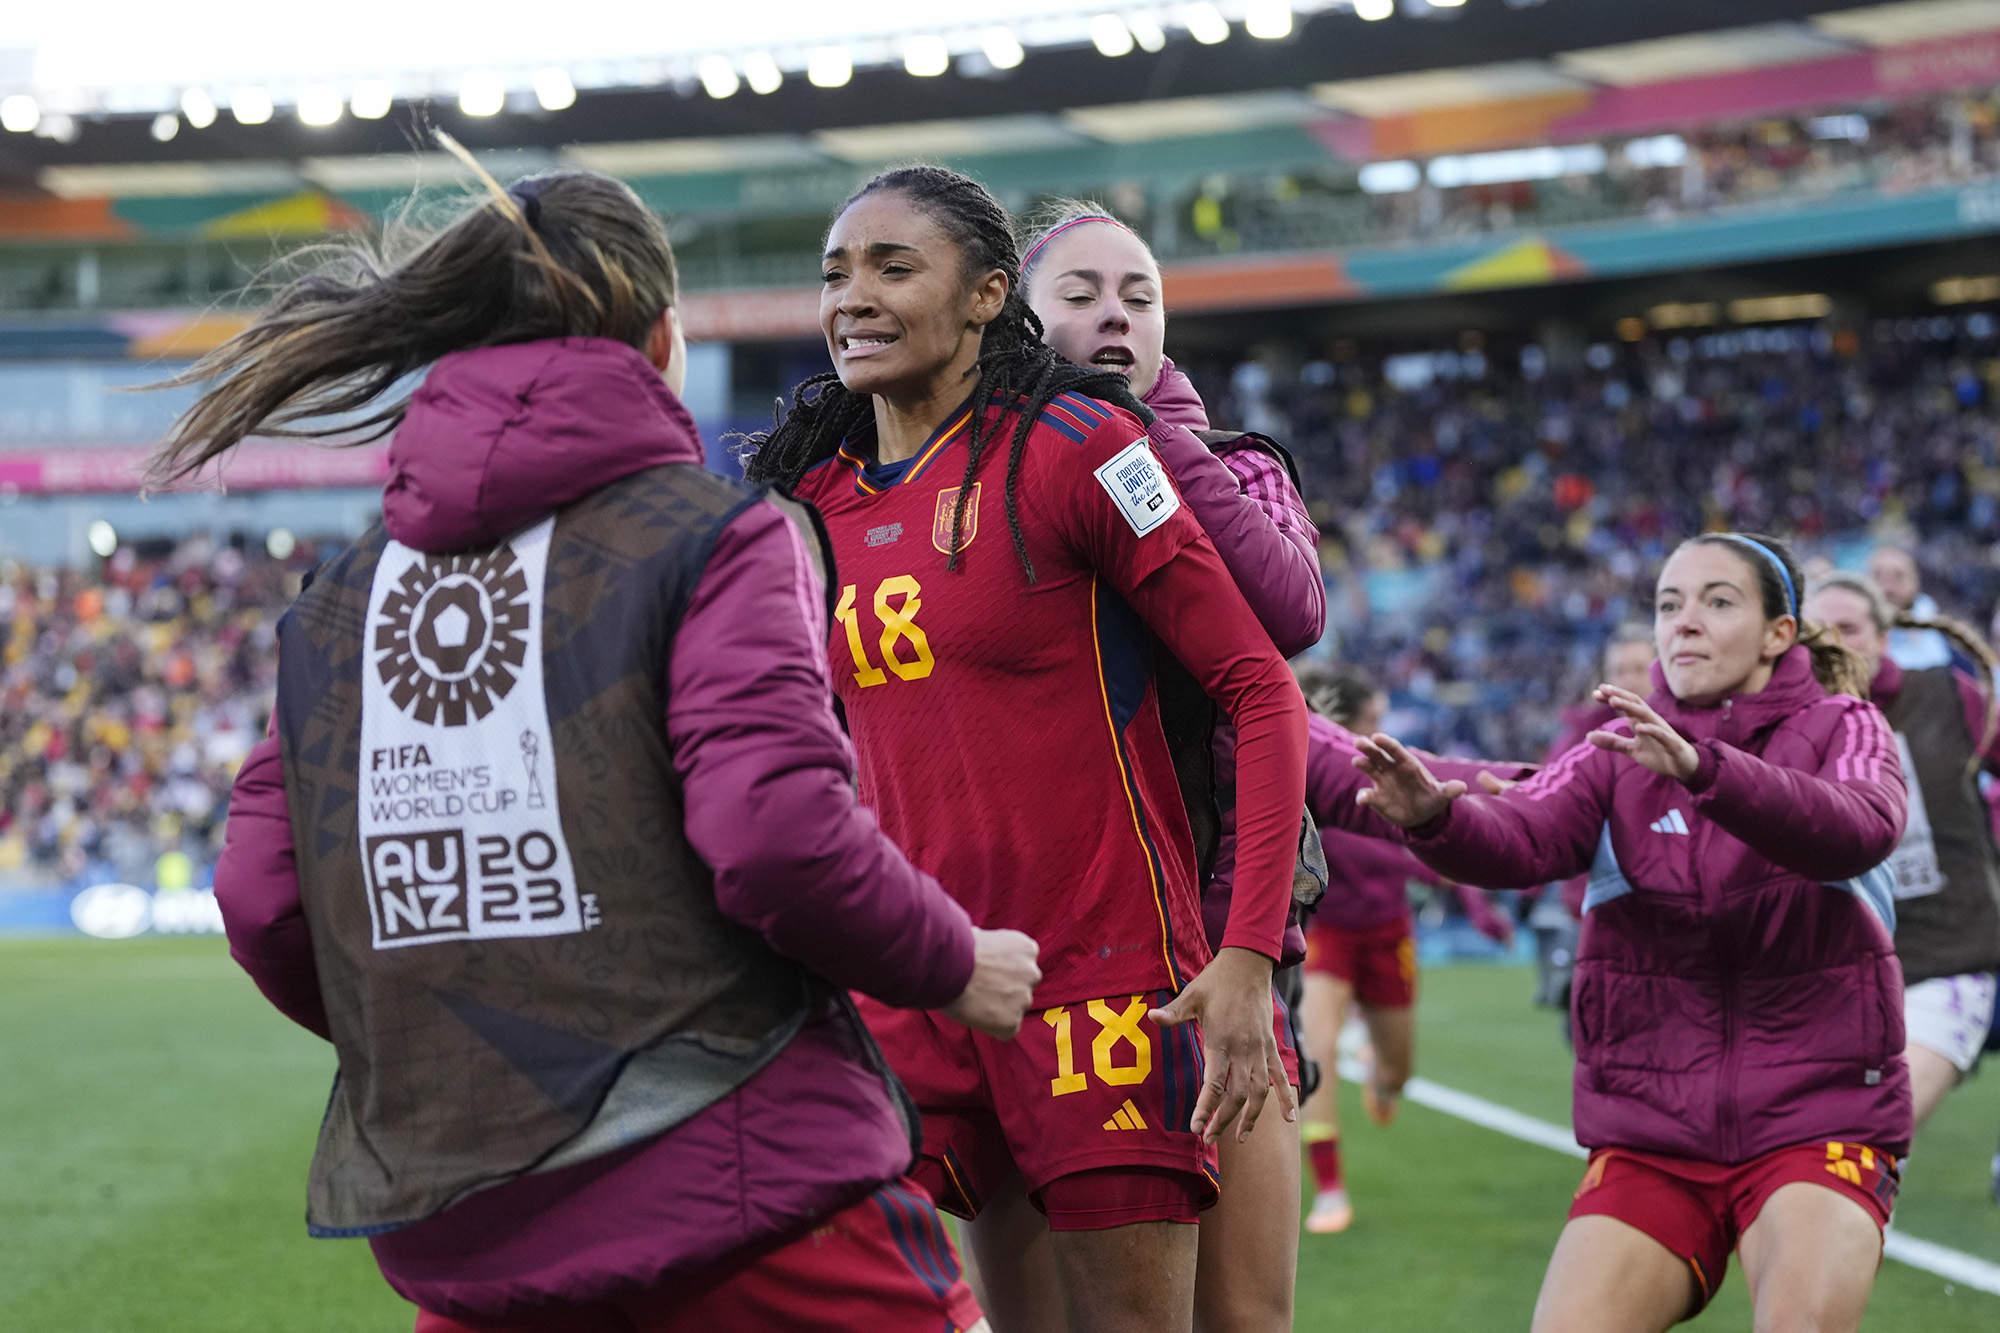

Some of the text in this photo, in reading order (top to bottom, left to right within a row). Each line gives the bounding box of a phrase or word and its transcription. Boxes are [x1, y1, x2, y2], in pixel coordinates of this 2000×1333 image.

[1115, 454, 1148, 483] FOOTBALL
[1122, 463, 1156, 494] UNITES
[1130, 493, 1146, 507] the
[834, 574, 935, 689] 18
[371, 744, 431, 771] FIFA
[370, 765, 490, 796] WOMEN'S
[370, 788, 518, 822] WORLD CUP
[373, 836, 460, 888] AU
[380, 883, 463, 935] NZ
[1042, 992, 1152, 1097] 18
